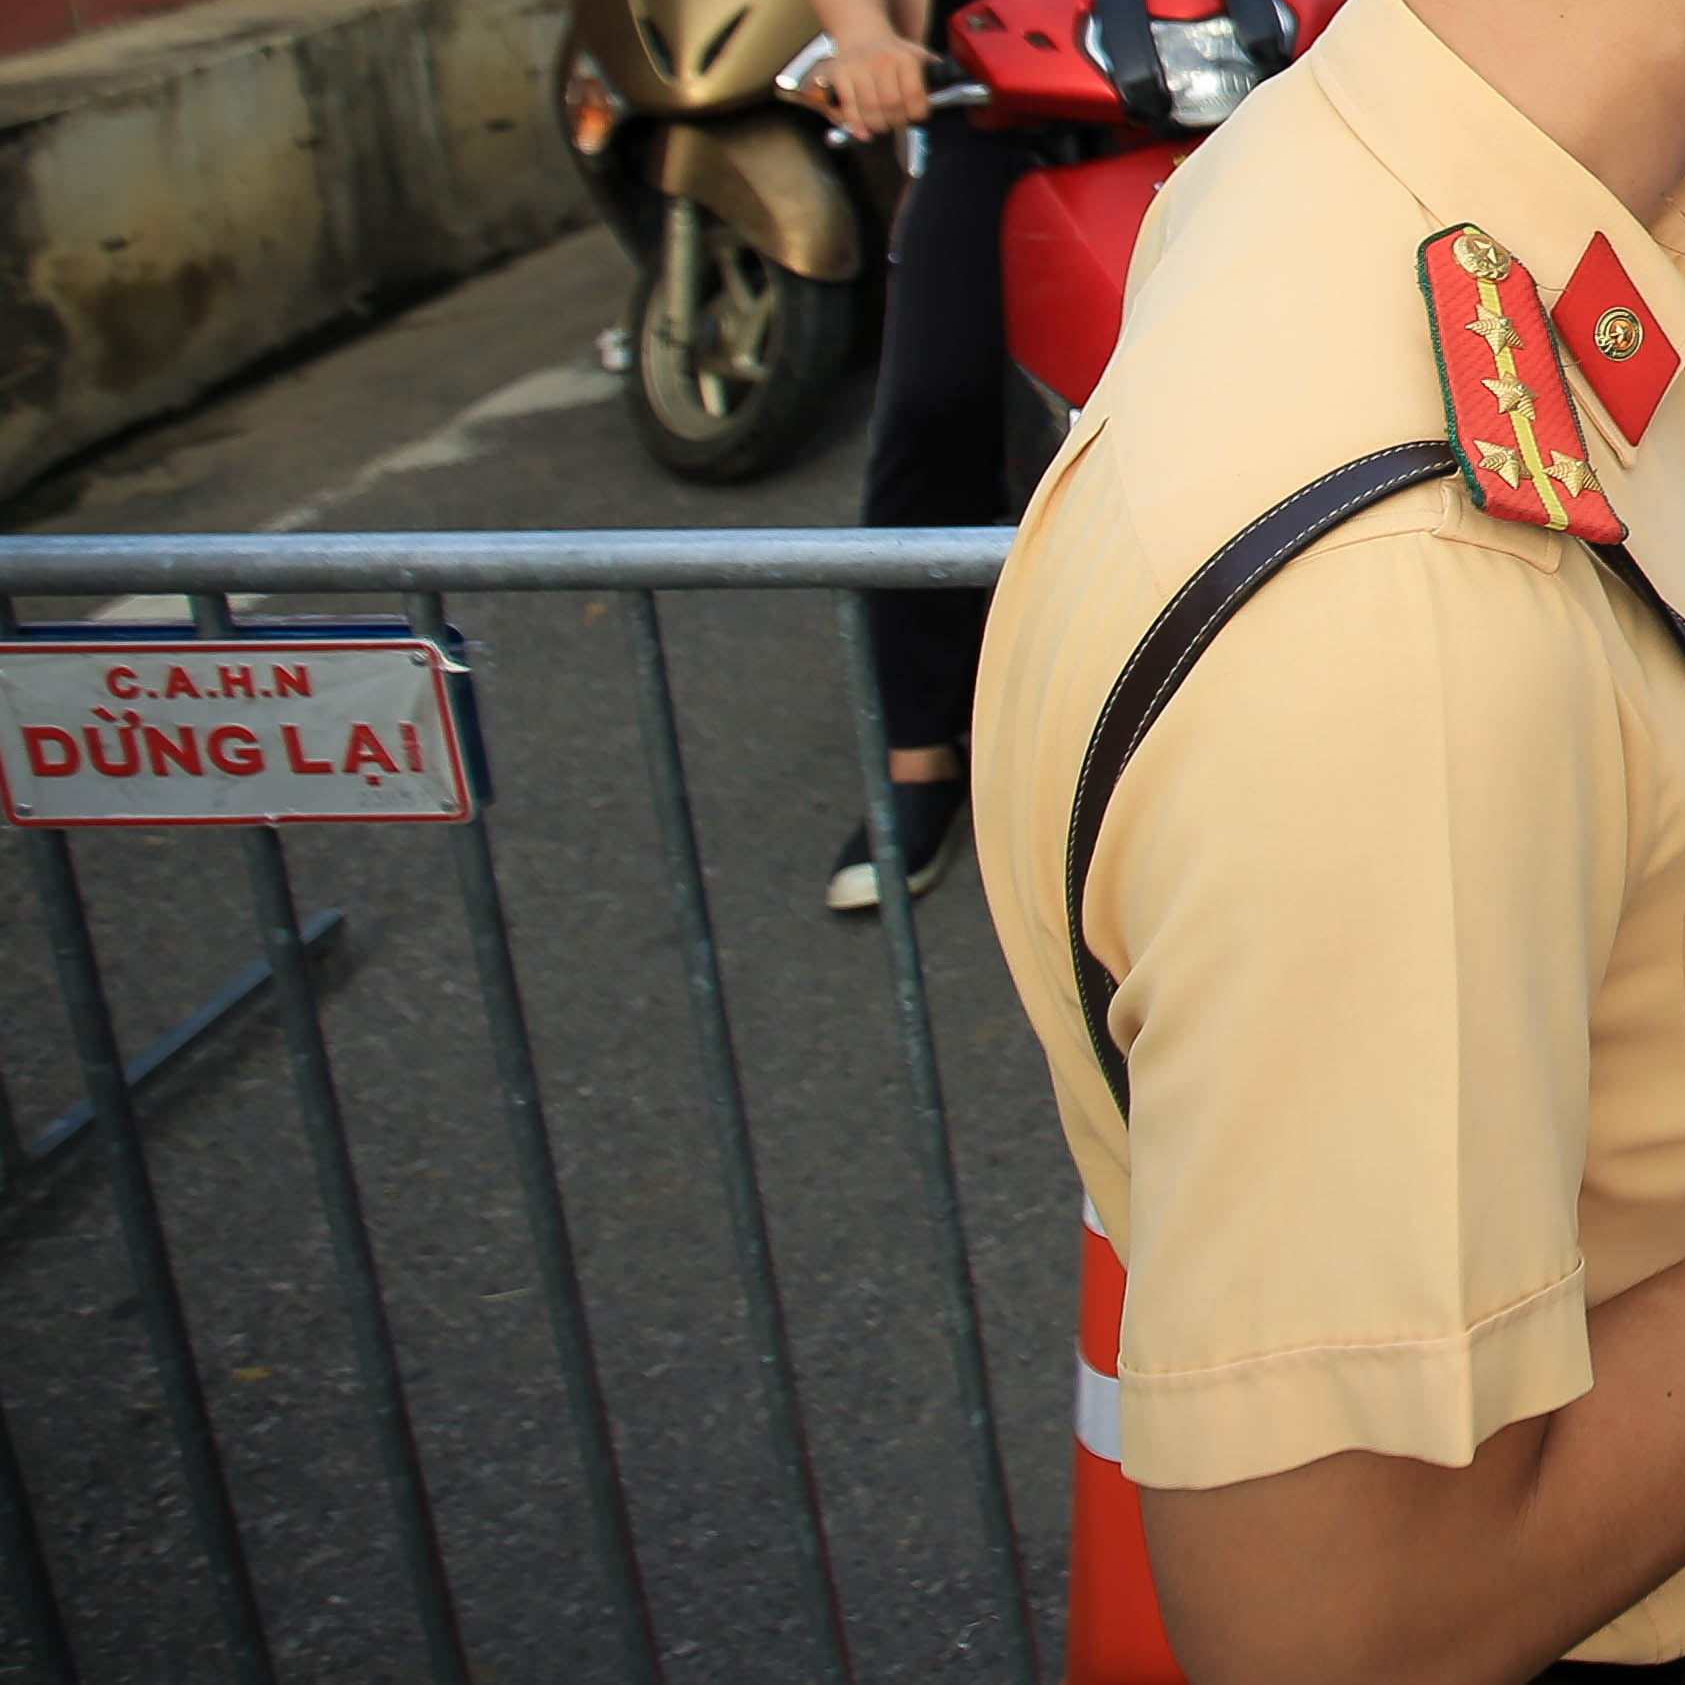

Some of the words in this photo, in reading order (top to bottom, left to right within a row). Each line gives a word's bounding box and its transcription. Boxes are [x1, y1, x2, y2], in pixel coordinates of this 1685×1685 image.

[105, 663, 314, 700] C.A.H.N
[20, 705, 266, 777] DỪNG
[280, 720, 426, 786] LẠI
